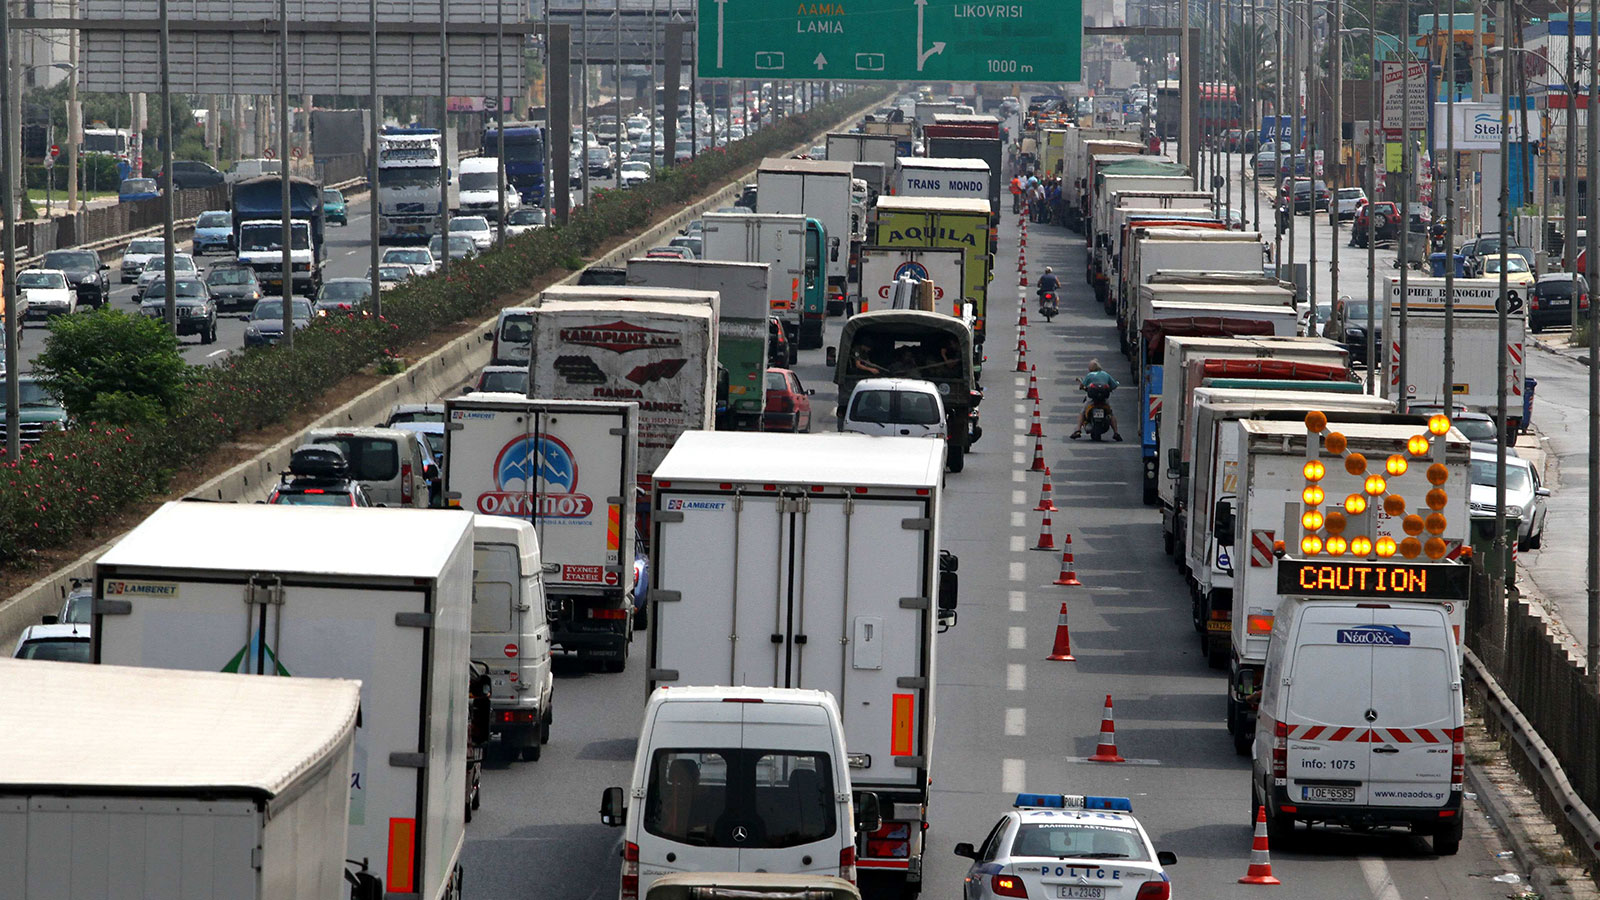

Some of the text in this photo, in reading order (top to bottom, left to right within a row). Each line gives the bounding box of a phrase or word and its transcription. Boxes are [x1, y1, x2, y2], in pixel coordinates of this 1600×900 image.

[797, 3, 845, 16] ΛΑΜΙΑ
[954, 5, 1023, 18] LIKOVRISI
[797, 20, 844, 33] LAMIA
[767, 55, 772, 67] 1
[868, 57, 873, 67] 1
[987, 60, 1034, 73] 1000 m
[907, 178, 983, 192] TRANS MONDO
[888, 226, 976, 247] AQUILA
[1393, 287, 1433, 297] OPHEE
[682, 501, 726, 510] LAMBERET
[1299, 565, 1427, 592] CAUTION
[123, 585, 177, 595] LAMBERET
[1302, 758, 1356, 770] info: 1075
[1374, 791, 1445, 800] www.neaodos.gr
[1064, 797, 1084, 808] POLICE
[1041, 866, 1121, 880] POLICE
